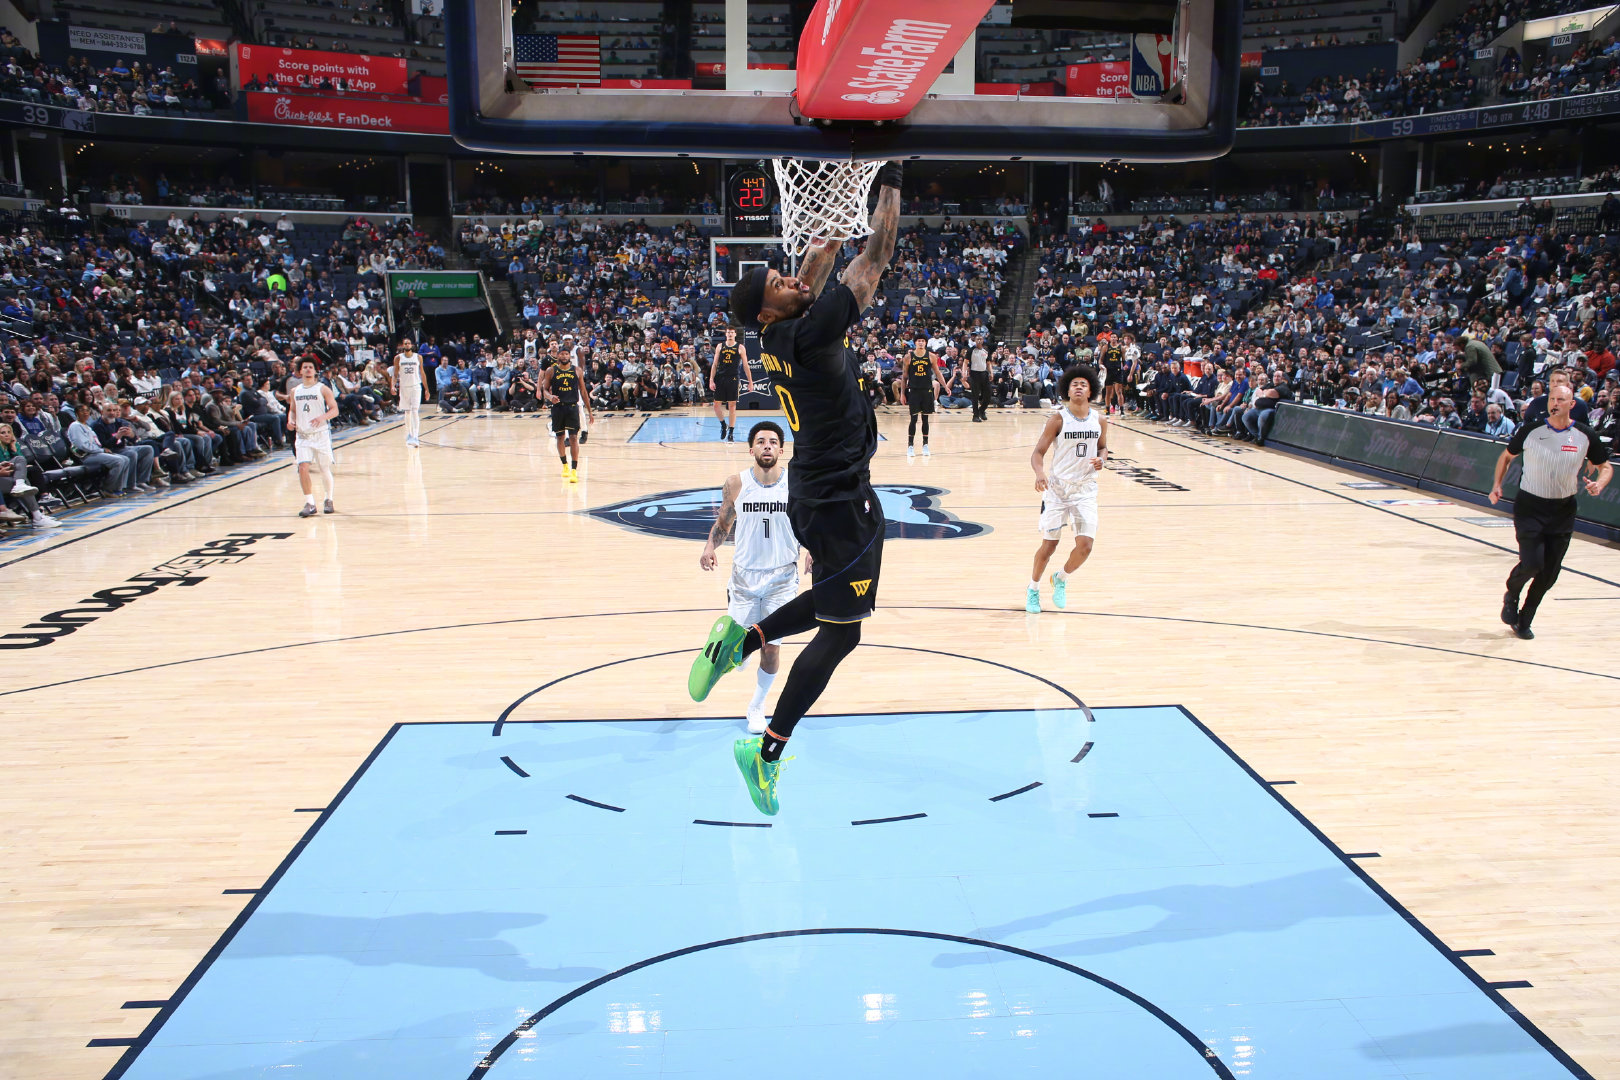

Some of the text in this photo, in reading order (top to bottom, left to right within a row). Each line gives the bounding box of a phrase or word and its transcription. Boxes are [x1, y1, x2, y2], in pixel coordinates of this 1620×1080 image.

[69, 29, 145, 44] NEED ASSISTANCE?
[79, 38, 96, 46] MEM
[1553, 35, 1571, 46] 107A
[179, 55, 196, 63] 112A
[278, 59, 369, 76] Score points with
[275, 72, 294, 84] the
[356, 78, 376, 91] App
[1100, 73, 1128, 83] Score
[1135, 75, 1156, 92] NBA
[1096, 87, 1112, 96] the
[22, 105, 49, 125] 39
[1482, 113, 1498, 124] 2ND
[1522, 102, 1550, 121] 4:48
[338, 114, 392, 128] FanDeck
[1391, 119, 1413, 136] 59
[743, 177, 765, 188] 4:47
[739, 188, 764, 207] 22
[395, 279, 428, 293] Sprite
[917, 364, 924, 372] 15
[563, 378, 569, 386] 4
[741, 383, 768, 391] SNIC
[302, 403, 311, 413] 4
[774, 384, 800, 432] 0
[1076, 442, 1087, 457] 0
[1364, 428, 1408, 458] Sprite
[742, 500, 789, 514] memphi
[762, 518, 770, 539] 1
